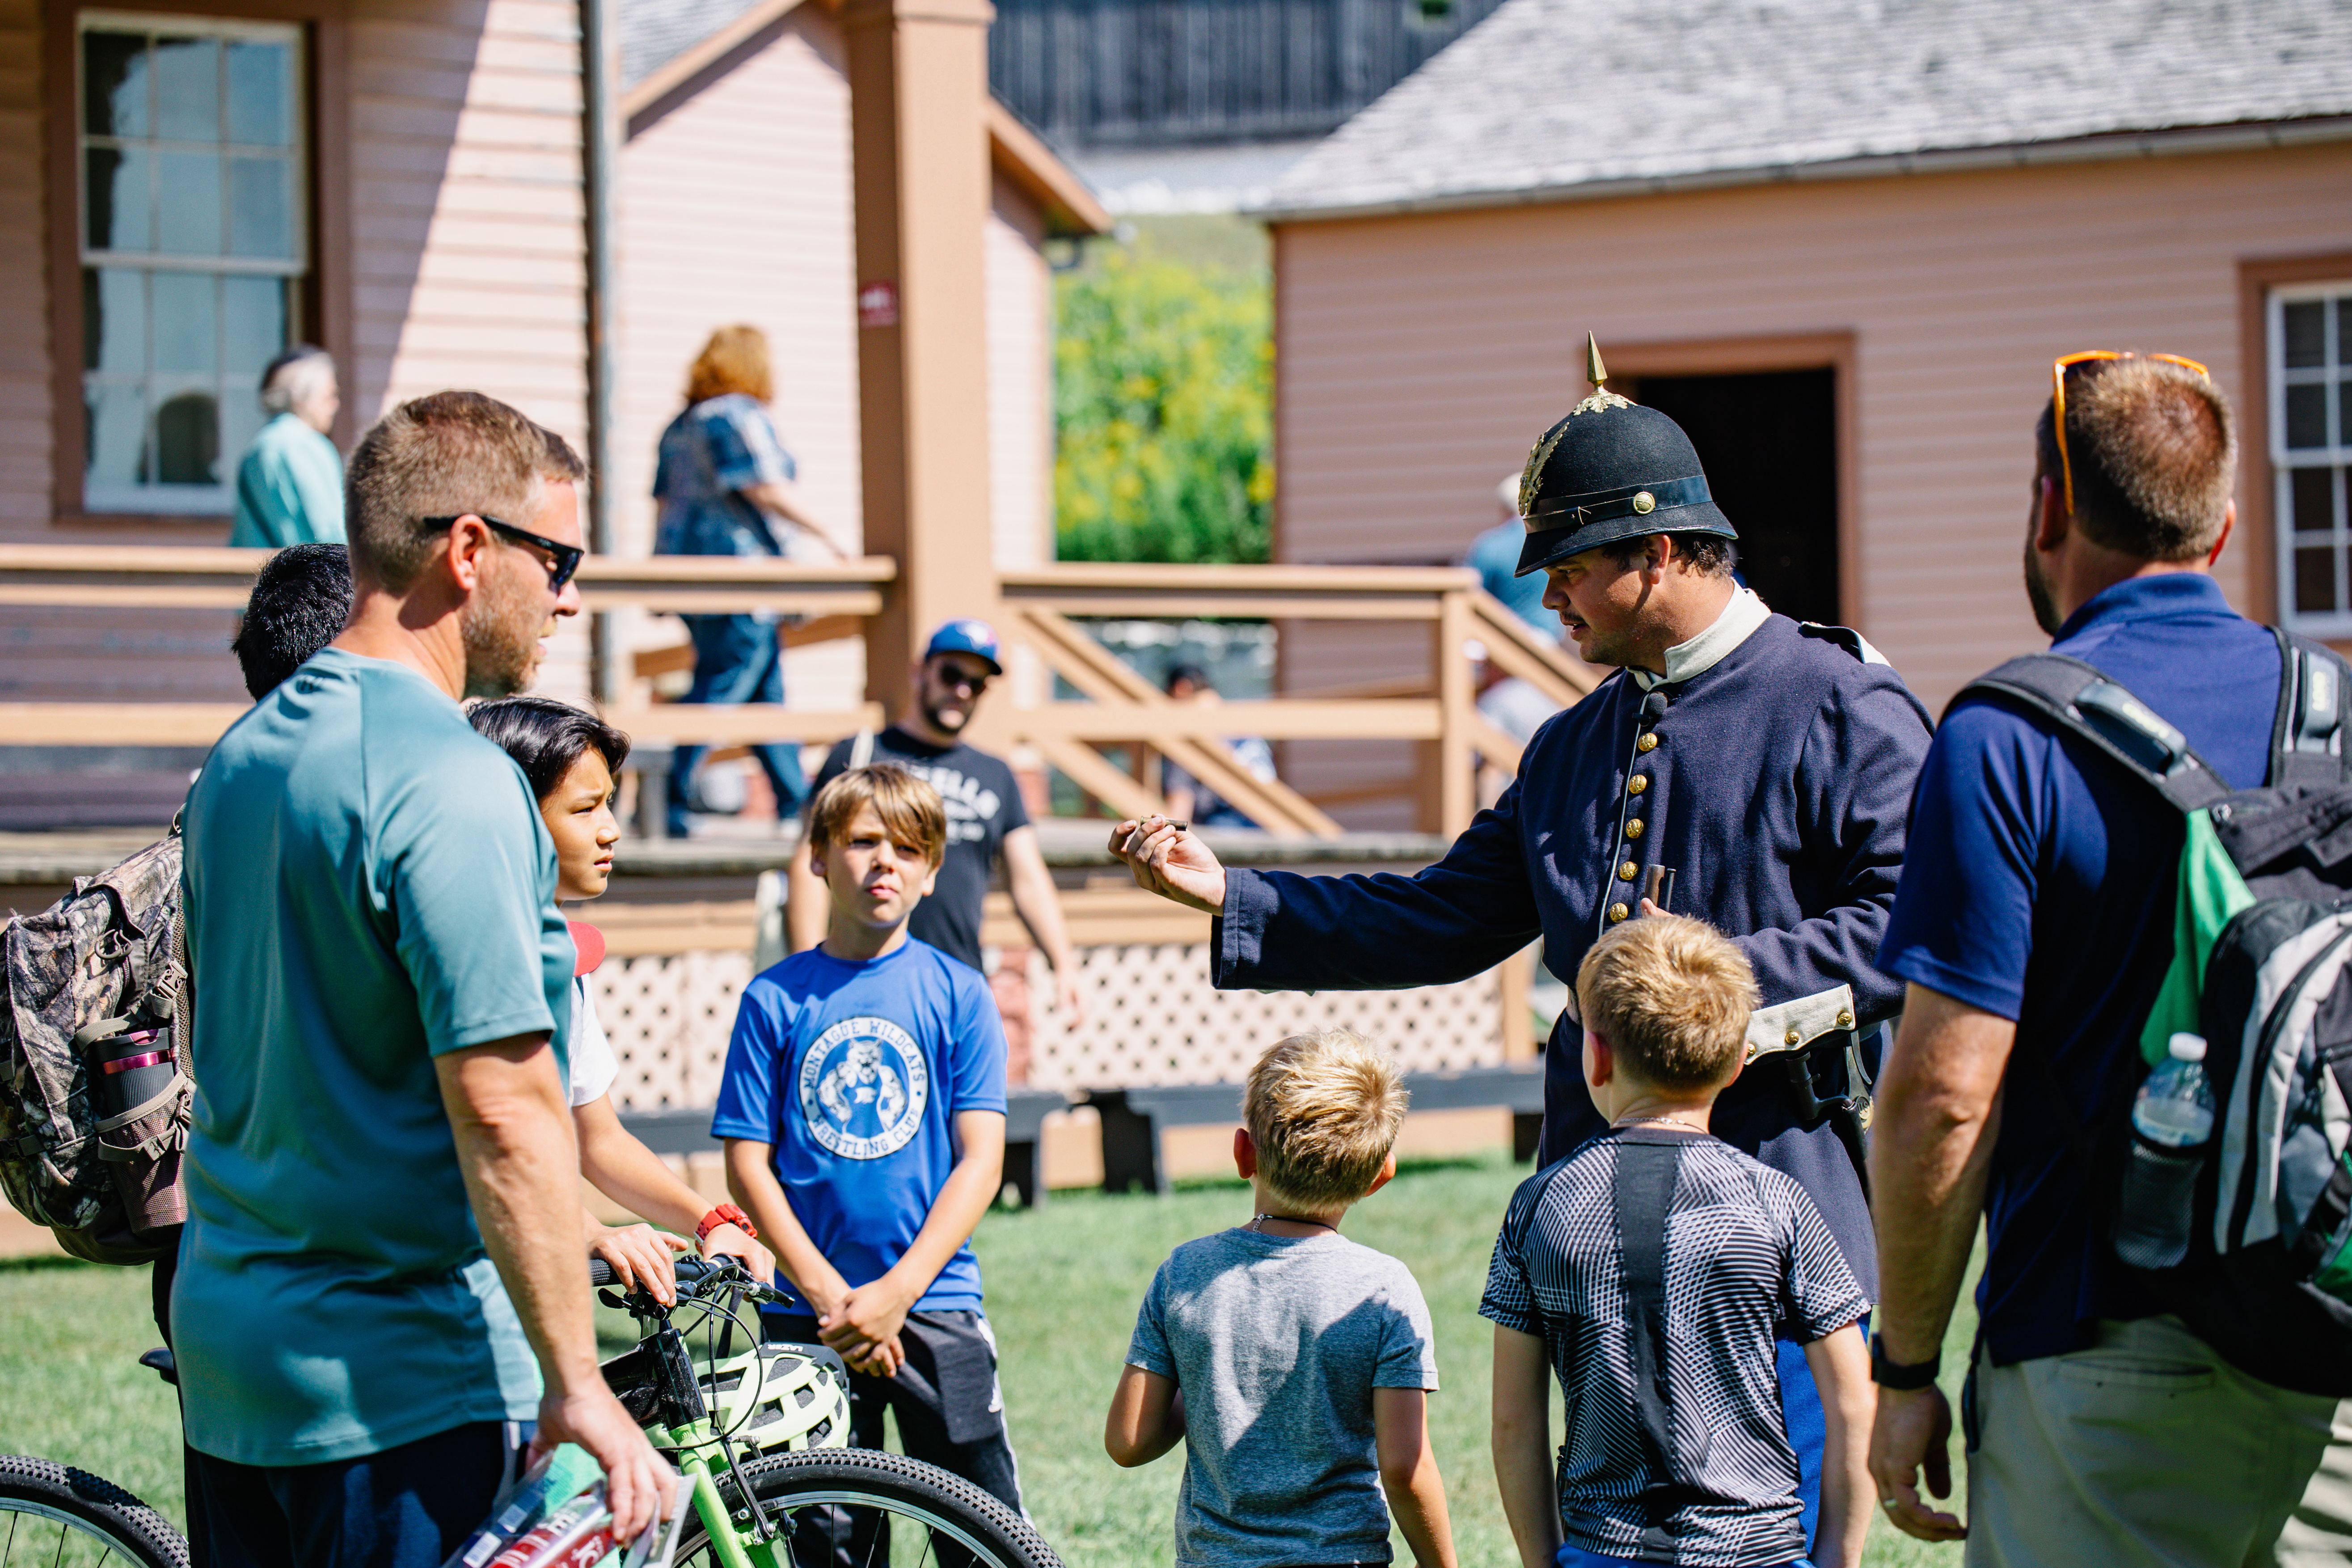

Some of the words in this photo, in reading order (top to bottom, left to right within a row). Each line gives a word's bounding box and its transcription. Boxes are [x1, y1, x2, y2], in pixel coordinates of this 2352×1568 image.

[803, 1021, 860, 1089] MONTAGUE
[870, 1020, 925, 1082] WILDCATS
[1857, 1101, 1869, 1114] US
[813, 1113, 888, 1156] WRESTLING
[768, 1344, 803, 1352] LAZER
